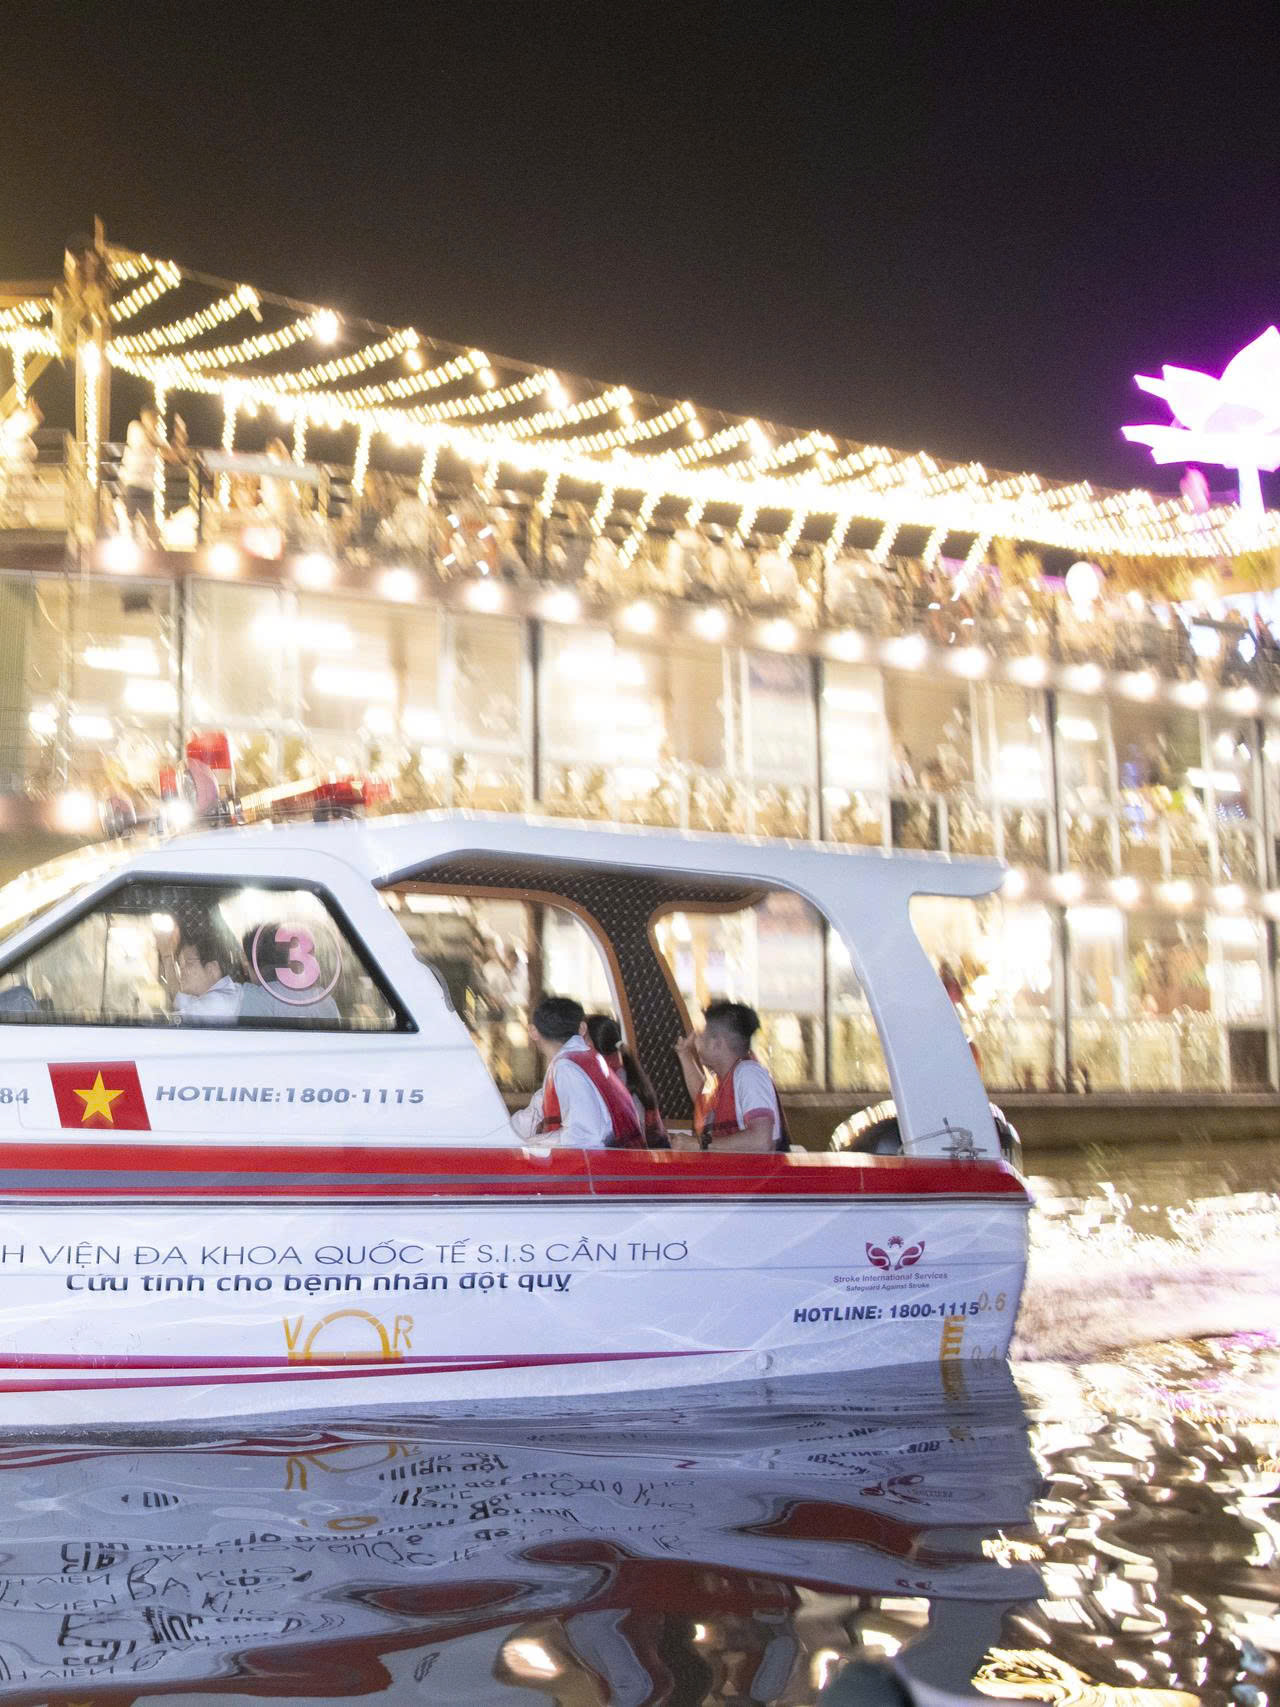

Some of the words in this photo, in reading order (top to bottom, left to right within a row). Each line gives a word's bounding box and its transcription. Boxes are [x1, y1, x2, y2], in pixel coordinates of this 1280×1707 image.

[275, 927, 320, 989] 3
[0, 1087, 30, 1104] 84
[39, 1241, 120, 1268] VIỆN
[134, 1245, 187, 1265] ĐA
[202, 1245, 302, 1265] KHOA
[314, 1239, 424, 1265] QUỐC
[436, 1238, 470, 1264] TẾ
[477, 1244, 535, 1264] S.I.S
[546, 1236, 617, 1263] CẦN
[627, 1240, 689, 1262] THƠ
[217, 1273, 273, 1292] cho
[833, 1274, 860, 1284] Stroke
[862, 1272, 912, 1283] International
[914, 1271, 948, 1281] Services
[845, 1284, 880, 1293] Safeguard
[881, 1283, 907, 1291] Against
[908, 1281, 930, 1289] Stroke
[793, 1305, 882, 1323] HOTLINE:
[889, 1301, 979, 1319] 1800-1115
